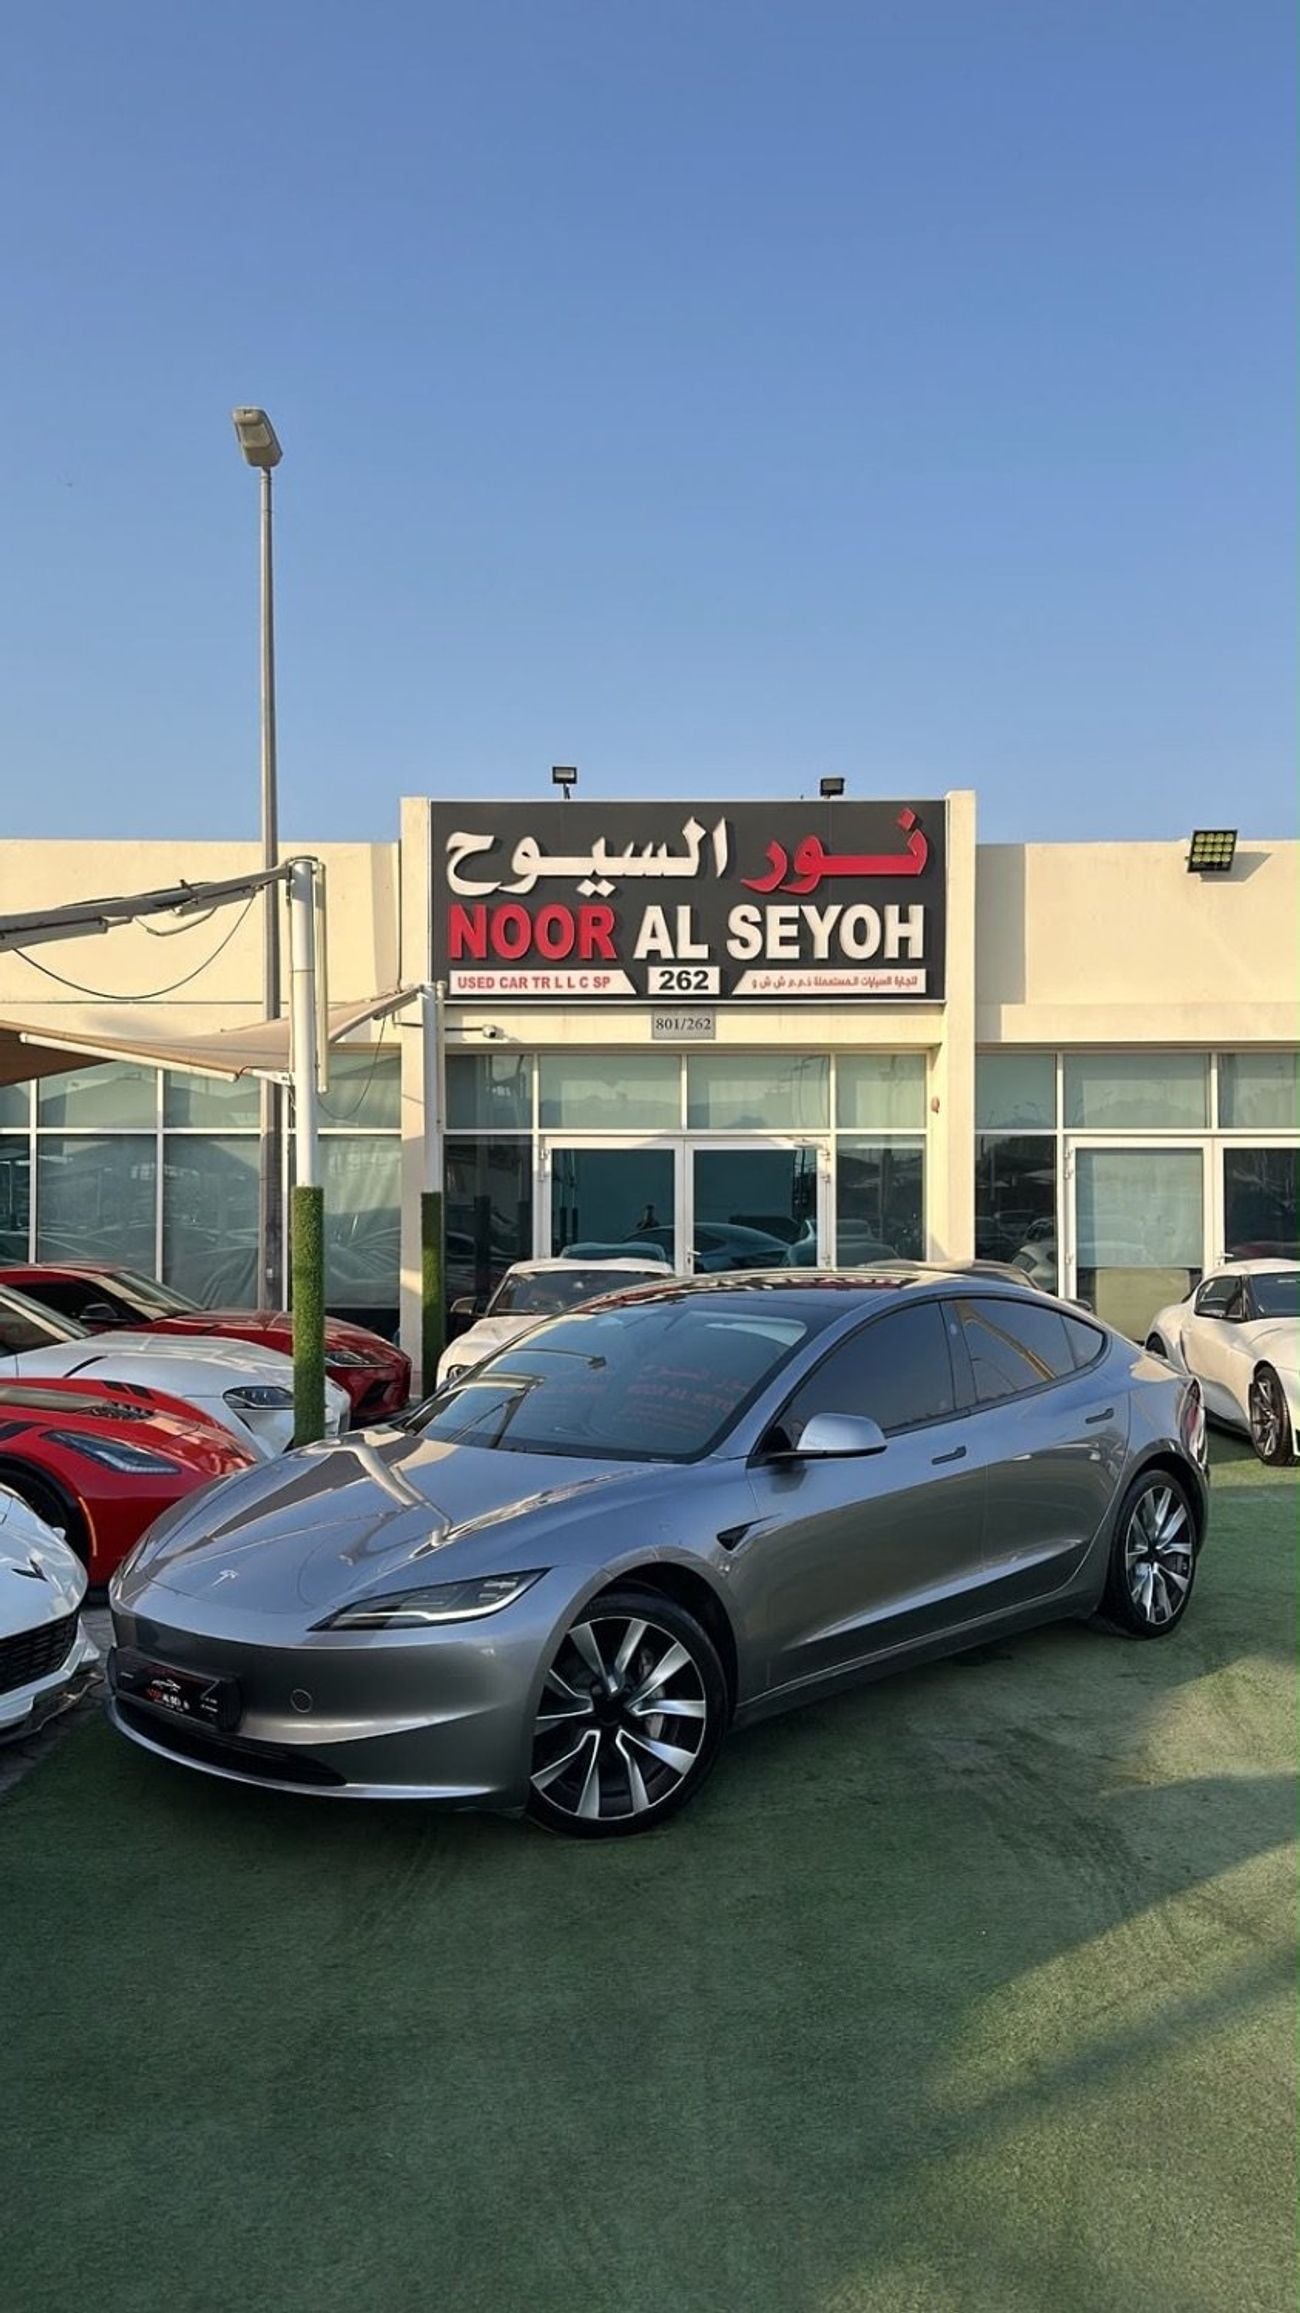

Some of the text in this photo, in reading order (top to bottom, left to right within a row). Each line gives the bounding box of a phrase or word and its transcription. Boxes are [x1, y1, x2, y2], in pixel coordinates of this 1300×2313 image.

[446, 807, 928, 897] نور السيوح
[448, 903, 924, 961] NOOR AL SEYOH
[457, 975, 495, 990] USED
[499, 975, 528, 990] CAR
[532, 975, 550, 989] TR
[578, 975, 589, 989] C
[592, 975, 611, 989] SP
[658, 969, 709, 991] 262
[860, 975, 893, 989] السيارات
[655, 1017, 711, 1031] 801/262
